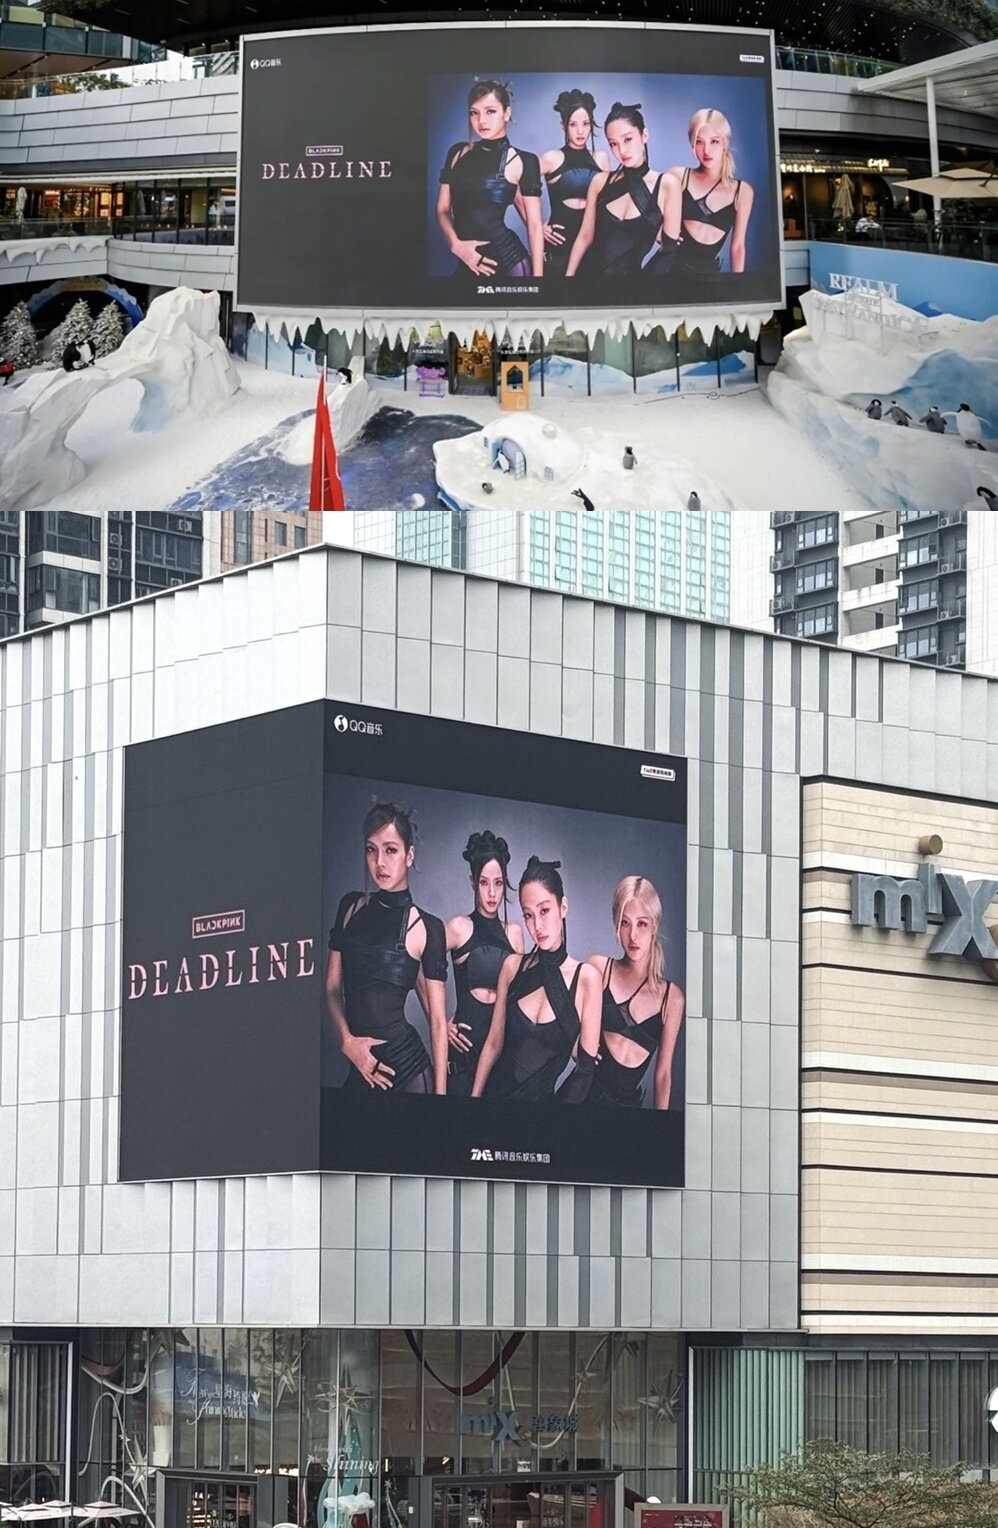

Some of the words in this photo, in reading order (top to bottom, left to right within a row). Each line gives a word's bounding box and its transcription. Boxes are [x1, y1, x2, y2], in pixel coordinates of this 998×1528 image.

[262, 161, 392, 180] DEADLINE
[829, 273, 899, 301] REALM
[350, 719, 383, 736] QQ音乐
[195, 917, 242, 933] BLACKPINK
[128, 938, 315, 1000] DEADLINE
[494, 1151, 551, 1164] 腾讯音乐娱乐集团
